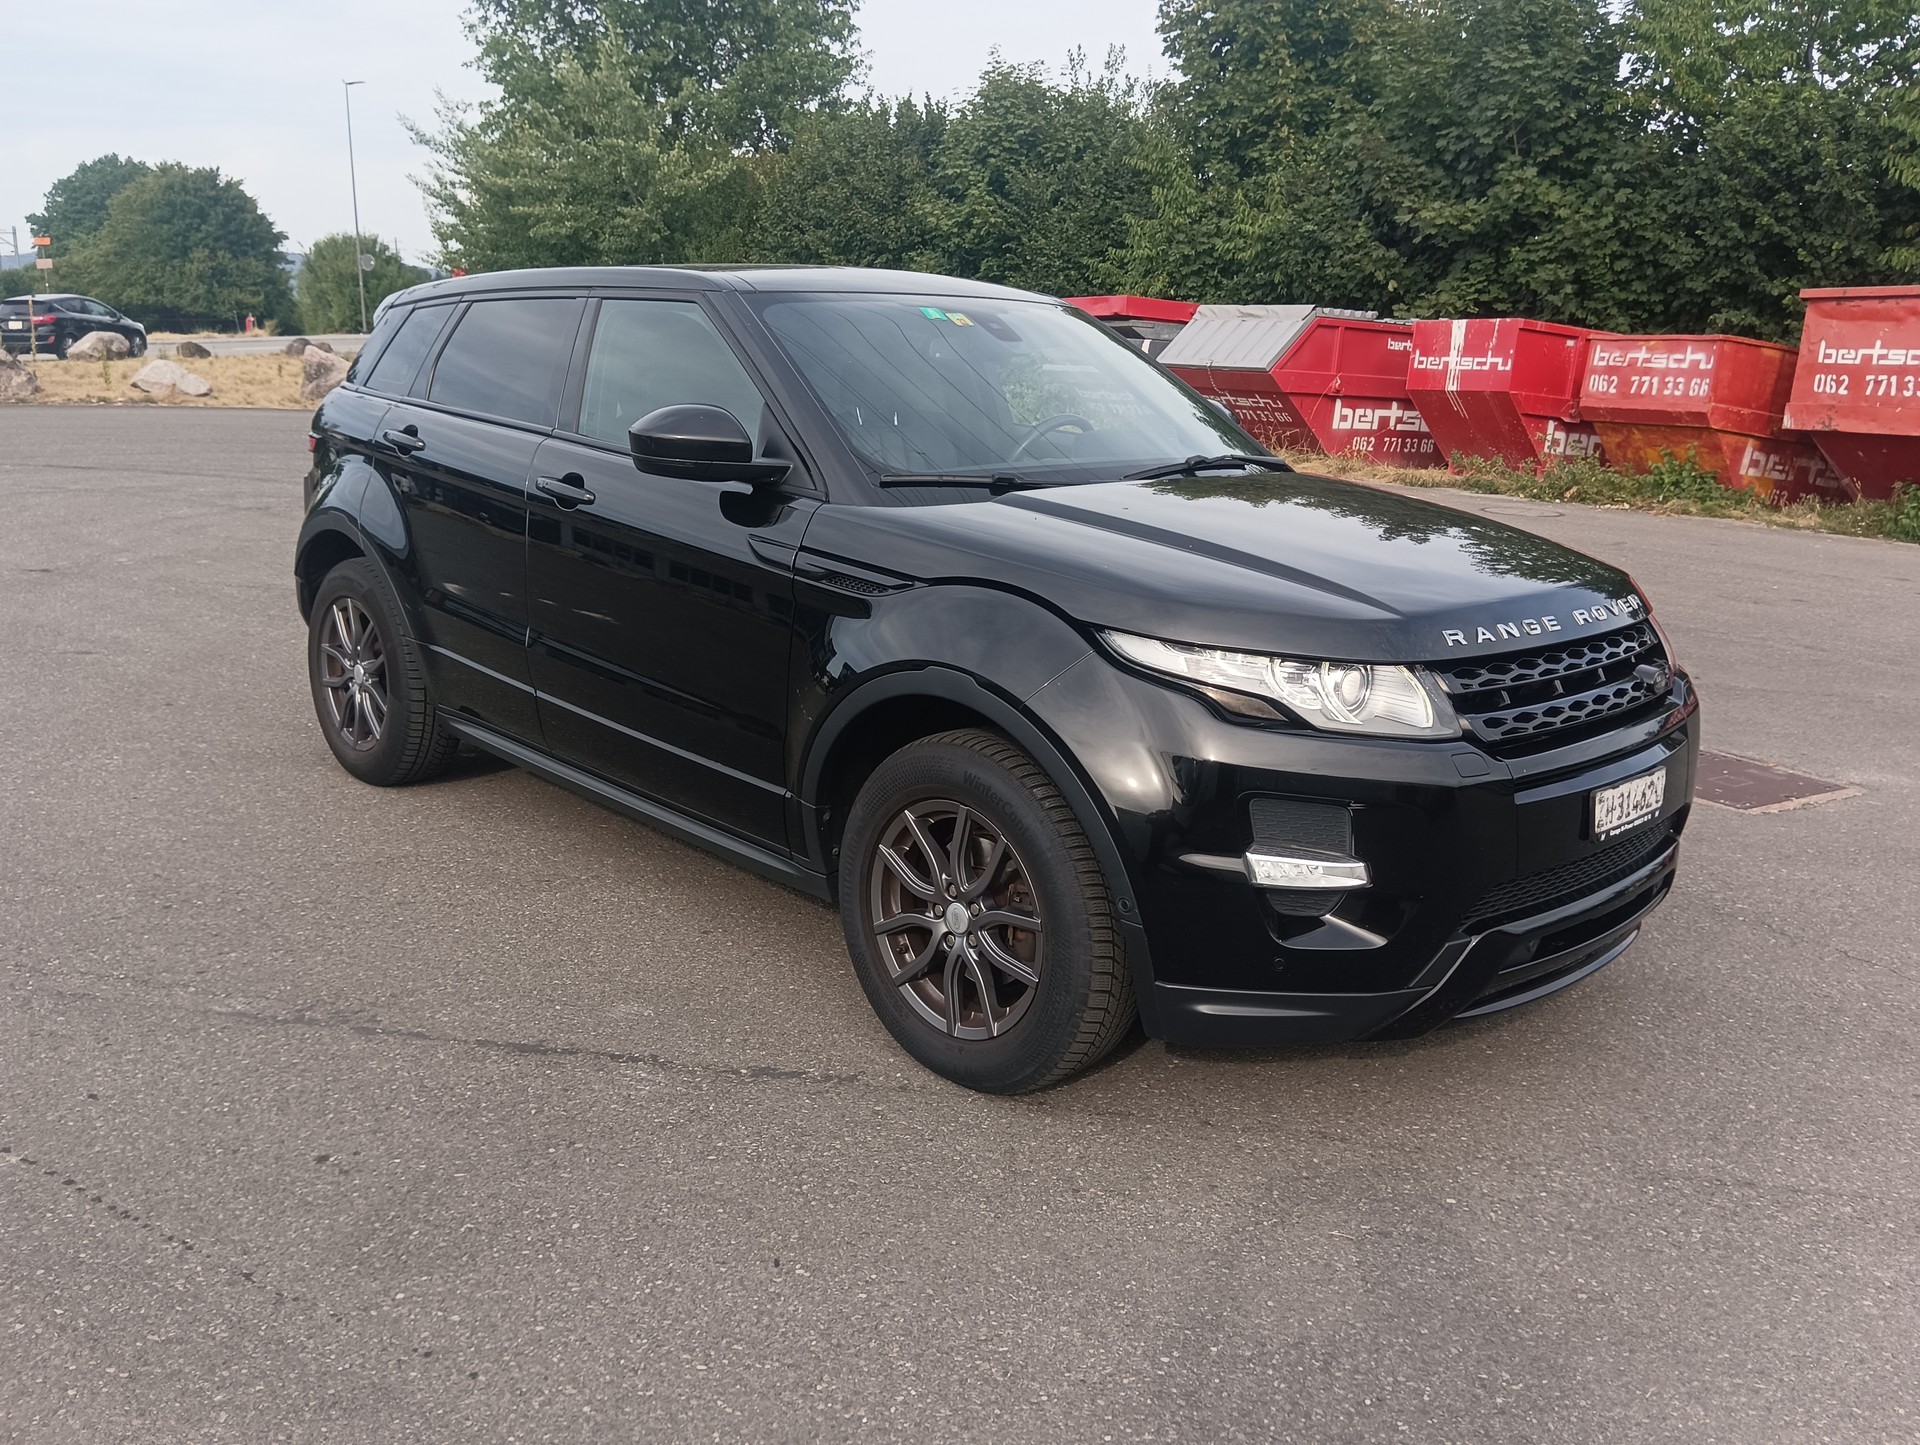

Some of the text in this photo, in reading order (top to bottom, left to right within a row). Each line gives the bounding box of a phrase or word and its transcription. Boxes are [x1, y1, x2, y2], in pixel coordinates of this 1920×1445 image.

[1387, 337, 1413, 352] bert
[1413, 349, 1514, 371] bertschi
[1593, 344, 1717, 370] bertschi
[1588, 374, 1710, 397] 062 771 33 66
[1813, 373, 1849, 395] 062
[1865, 374, 1897, 397] 771
[1234, 409, 1258, 422] 771
[1352, 436, 1435, 454] 062 771 33 66
[1441, 593, 1644, 647] RANGE ROVER
